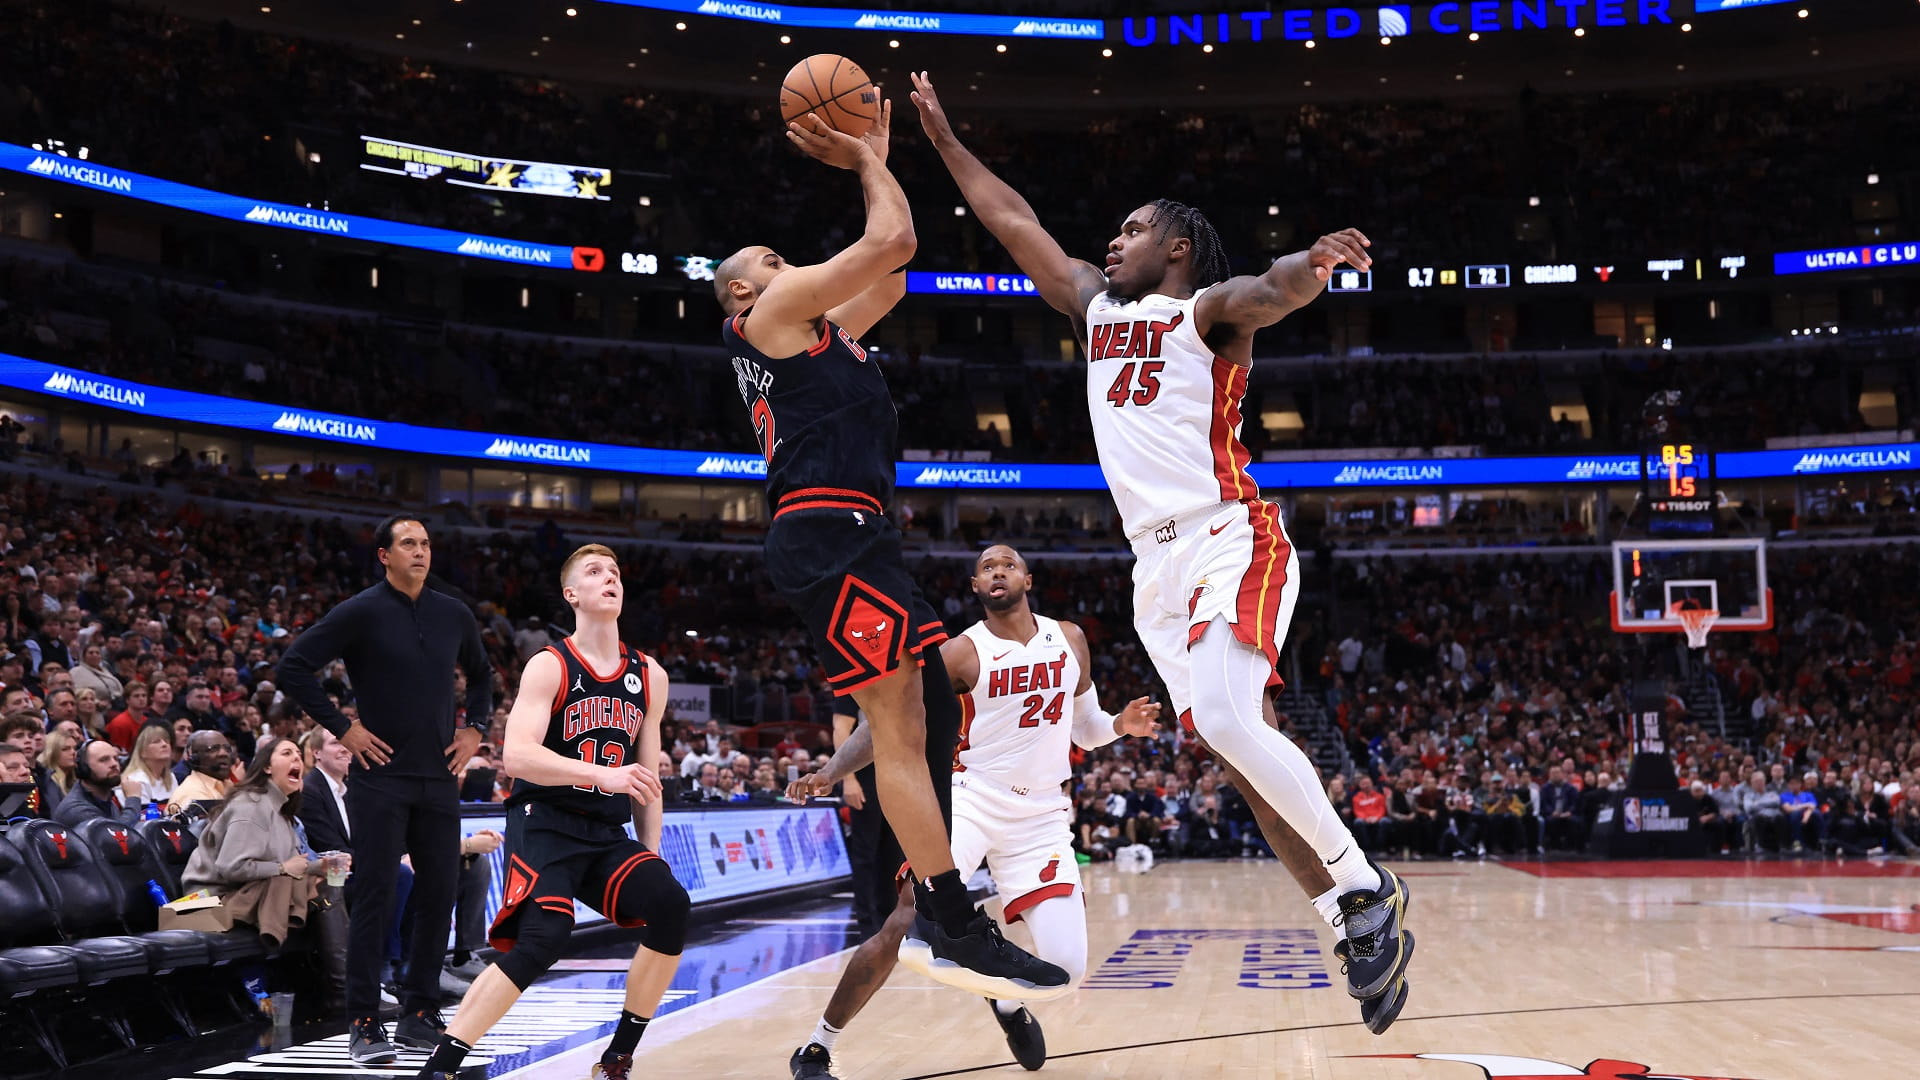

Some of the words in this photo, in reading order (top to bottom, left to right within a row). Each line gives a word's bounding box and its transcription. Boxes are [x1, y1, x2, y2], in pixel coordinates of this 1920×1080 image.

[718, 3, 781, 21] MAGELLAN
[877, 15, 940, 29] MAGELLAN
[1032, 22, 1097, 35] MAGELLAN
[1122, 8, 1361, 47] UNITED
[1429, 0, 1673, 33] CENTER
[53, 162, 131, 191] MAGELLAN
[272, 210, 348, 232] MAGELLAN
[480, 242, 551, 263] MAGELLAN
[1806, 250, 1857, 268] ULTRA
[936, 276, 983, 290] ULTRA
[1479, 268, 1498, 285] 72
[1524, 265, 1577, 284] CHICAGO
[1090, 310, 1184, 363] HEAT
[70, 381, 146, 408] MAGELLAN
[1107, 361, 1165, 408] 45
[299, 416, 377, 440] MAGELLAN
[512, 443, 590, 462] MAGELLAN
[1662, 444, 1693, 465] 8.5
[1822, 449, 1911, 467] MAGELLAN
[942, 469, 1021, 484] MAGELLAN
[1361, 465, 1442, 480] MAGELLAN
[1668, 501, 1711, 511] TISSOT
[988, 650, 1068, 698] HEAT
[1018, 691, 1066, 728] 24
[563, 696, 644, 746] CHICAGO
[572, 737, 626, 796] 13
[1078, 942, 1193, 989] UNITED
[1237, 942, 1333, 989] CENTER
